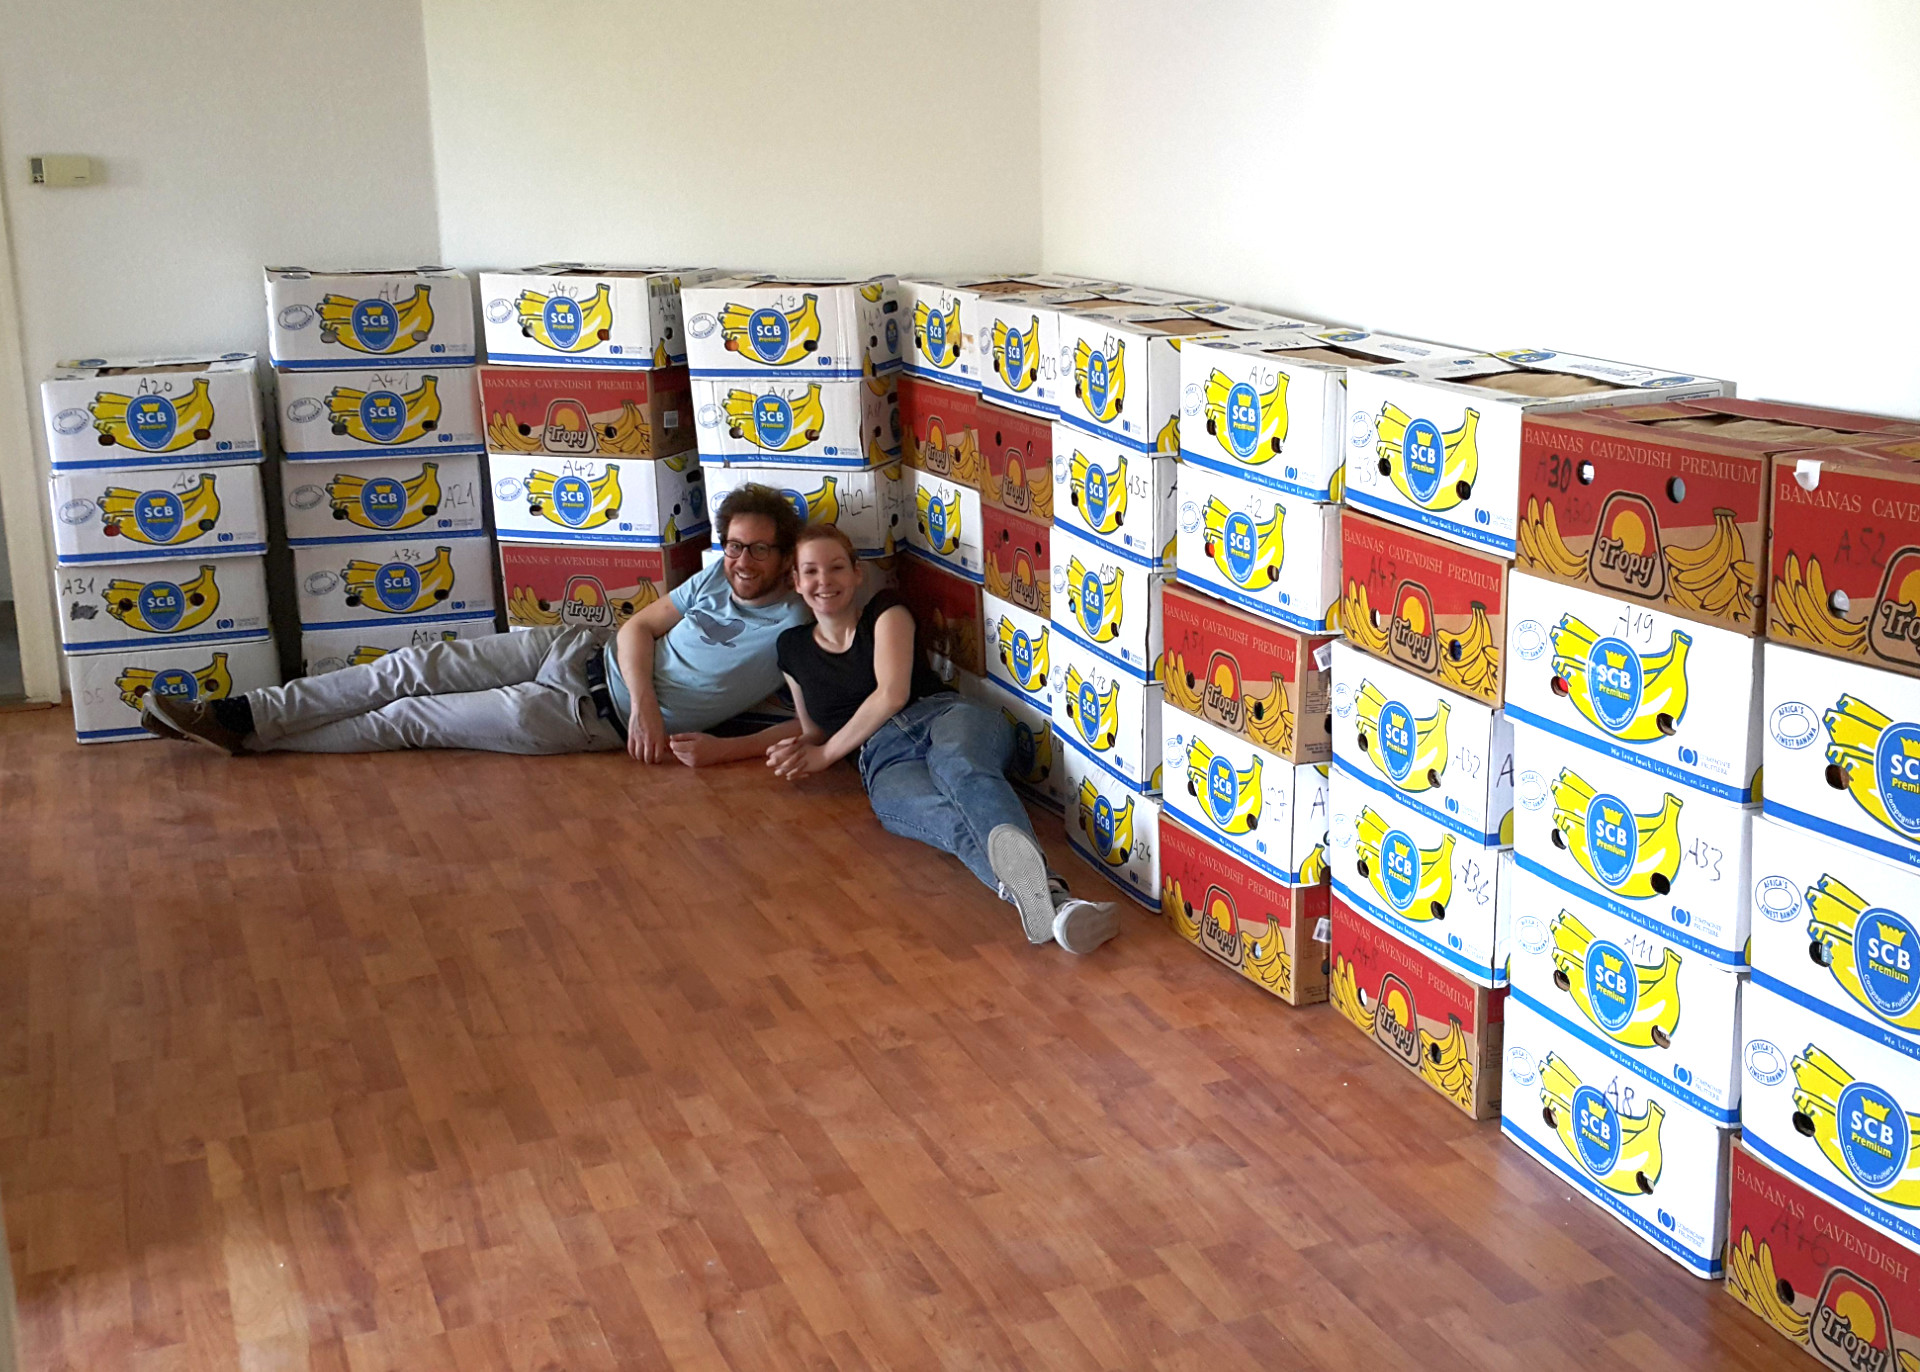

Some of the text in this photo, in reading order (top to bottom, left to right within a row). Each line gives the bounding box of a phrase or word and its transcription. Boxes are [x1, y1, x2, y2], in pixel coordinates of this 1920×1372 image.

[361, 315, 389, 326] SCB
[551, 312, 574, 323] SCB
[757, 325, 781, 336] SCB
[930, 327, 942, 338] SCB
[1008, 347, 1020, 359] SCB
[1040, 354, 1057, 380] A23
[137, 378, 172, 395] A20
[484, 378, 645, 391] BANANAS CAVENDISH PREMIUM
[1091, 371, 1105, 385] SCB
[136, 413, 167, 423] SCB
[369, 407, 397, 417] SCB
[759, 411, 784, 422] SCB
[1232, 405, 1256, 423] SCB
[549, 425, 588, 447] Tropy
[1410, 445, 1436, 464] SCB
[1524, 427, 1758, 485] BANANAS CAVENDISH PREMIUM
[562, 460, 595, 477] A42
[370, 493, 398, 503] SCB
[444, 482, 475, 509] A21
[560, 491, 584, 502] SCB
[1004, 476, 1025, 506] Tropy
[1089, 482, 1104, 498] SCB
[1780, 483, 1862, 513] BANANAS
[144, 506, 174, 517] SCB
[931, 512, 943, 526] SCB
[1230, 532, 1251, 551] SCB
[505, 554, 661, 569] BANANAS CAVENDISH PREMIUM
[1344, 528, 1499, 593] BANANAS CAVENDISH PREMIUM
[1599, 536, 1656, 588] Tropy
[62, 578, 95, 596] A31
[384, 578, 411, 588] SCB
[1014, 575, 1035, 605] Tropy
[147, 596, 176, 607] SCB
[1085, 590, 1099, 607] SCB
[567, 601, 605, 621] Tropy
[1164, 603, 1295, 664] BANANAS CAVENDISH PREMIUM
[1612, 605, 1654, 643] A19
[1394, 617, 1432, 663] Tropy
[1015, 646, 1029, 660] SCB
[1598, 663, 1632, 689] SCB
[161, 684, 188, 694] SCB
[1598, 683, 1631, 701] Premium
[1082, 699, 1096, 716] SCB
[1207, 683, 1240, 724] Tropy
[1778, 705, 1805, 716] AFRICA'S
[1385, 724, 1408, 746] SCB
[1796, 727, 1817, 746] BANANA
[1213, 774, 1232, 796] SCB
[1886, 792, 1916, 826] Compagnie
[1097, 814, 1110, 831] SCB
[1595, 819, 1627, 846] SCB
[1596, 838, 1626, 858] Premium
[1388, 852, 1412, 876] SCB
[1683, 837, 1723, 881] A33
[1161, 831, 1196, 858] BANANAS
[1199, 853, 1244, 885] CAVENDISH
[1247, 878, 1290, 910] PREMIUM
[1763, 878, 1789, 889] AFRICA'S
[1780, 902, 1800, 920] BANANA
[1205, 914, 1237, 957] Tropy
[1333, 908, 1371, 941] BANANAS
[1374, 934, 1424, 979] CAVENDISH
[1427, 972, 1473, 1013] PREMIUM
[1868, 937, 1911, 970] SCB
[1595, 964, 1627, 994] SCB
[1869, 960, 1909, 984] Premium
[1595, 983, 1626, 1005] Premium
[1864, 974, 1890, 1008] Compagnie
[1380, 1002, 1414, 1056] Tropy
[1751, 1040, 1775, 1054] AFRICA'S
[1883, 1033, 1913, 1054] We love
[1766, 1068, 1785, 1084] BANANA
[1580, 1108, 1611, 1140] SCB
[1851, 1110, 1895, 1146] SCB
[1581, 1128, 1611, 1151] Premium
[1851, 1132, 1892, 1159] Premium
[1846, 1145, 1872, 1181] Compagnie
[1736, 1165, 1909, 1284] BANANAS CAVENDISH
[1864, 1204, 1876, 1218] We
[1877, 1212, 1893, 1226] love
